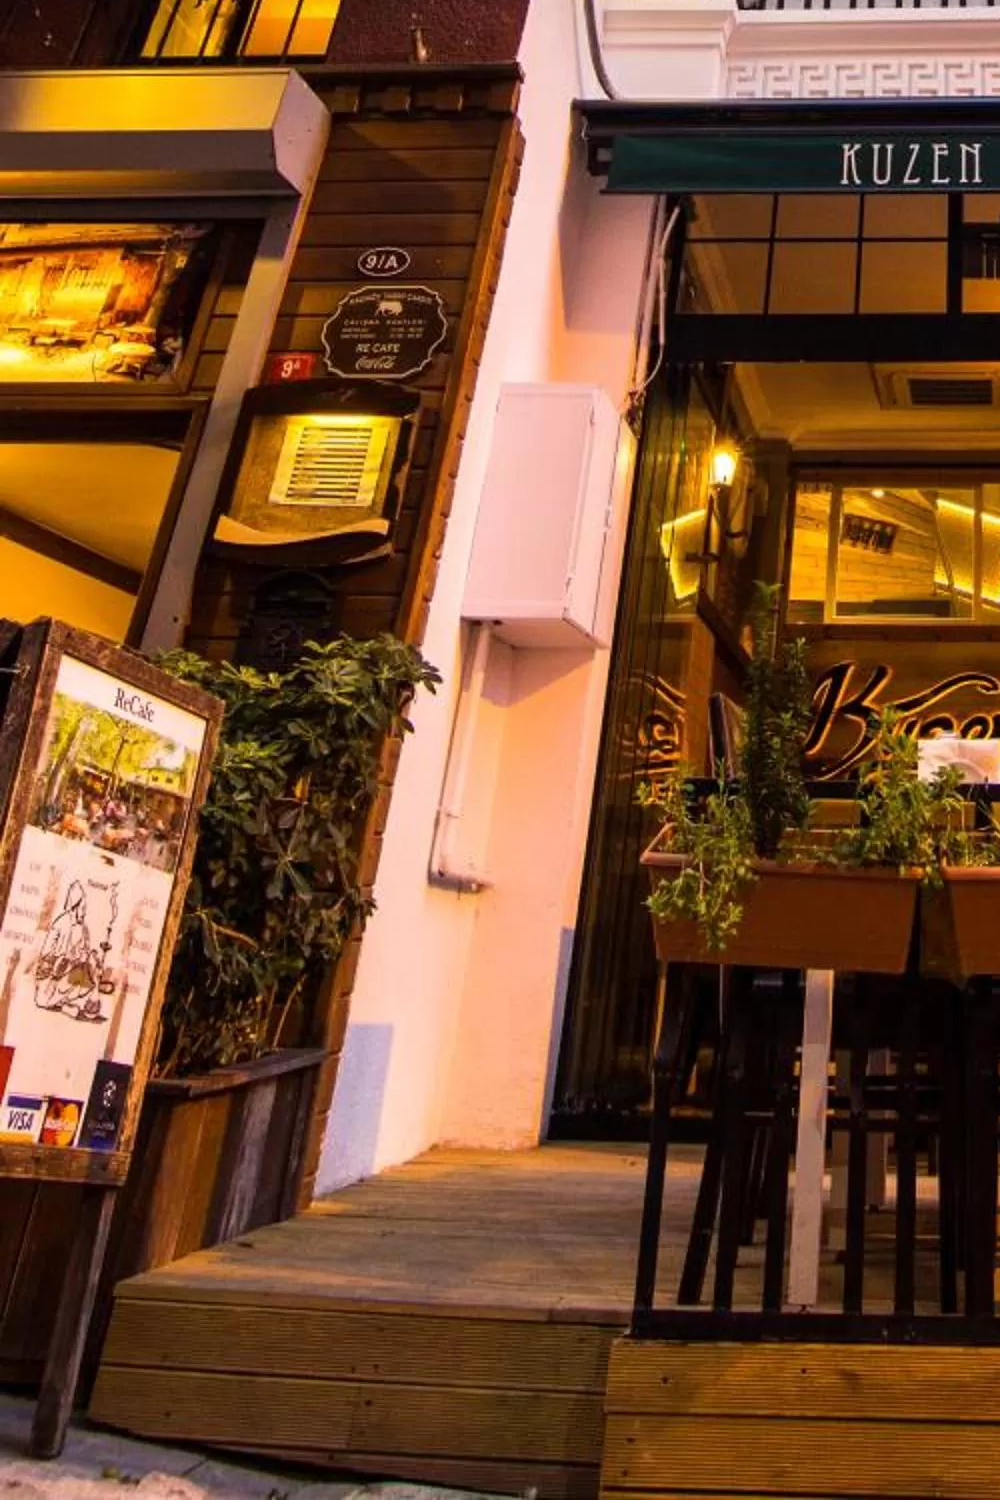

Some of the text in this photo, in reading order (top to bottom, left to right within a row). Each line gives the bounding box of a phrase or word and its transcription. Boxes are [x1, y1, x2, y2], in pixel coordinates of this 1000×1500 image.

[840, 142, 984, 185] KUZEN
[365, 254, 399, 269] 9/A
[7, 1109, 35, 1131] VISA
